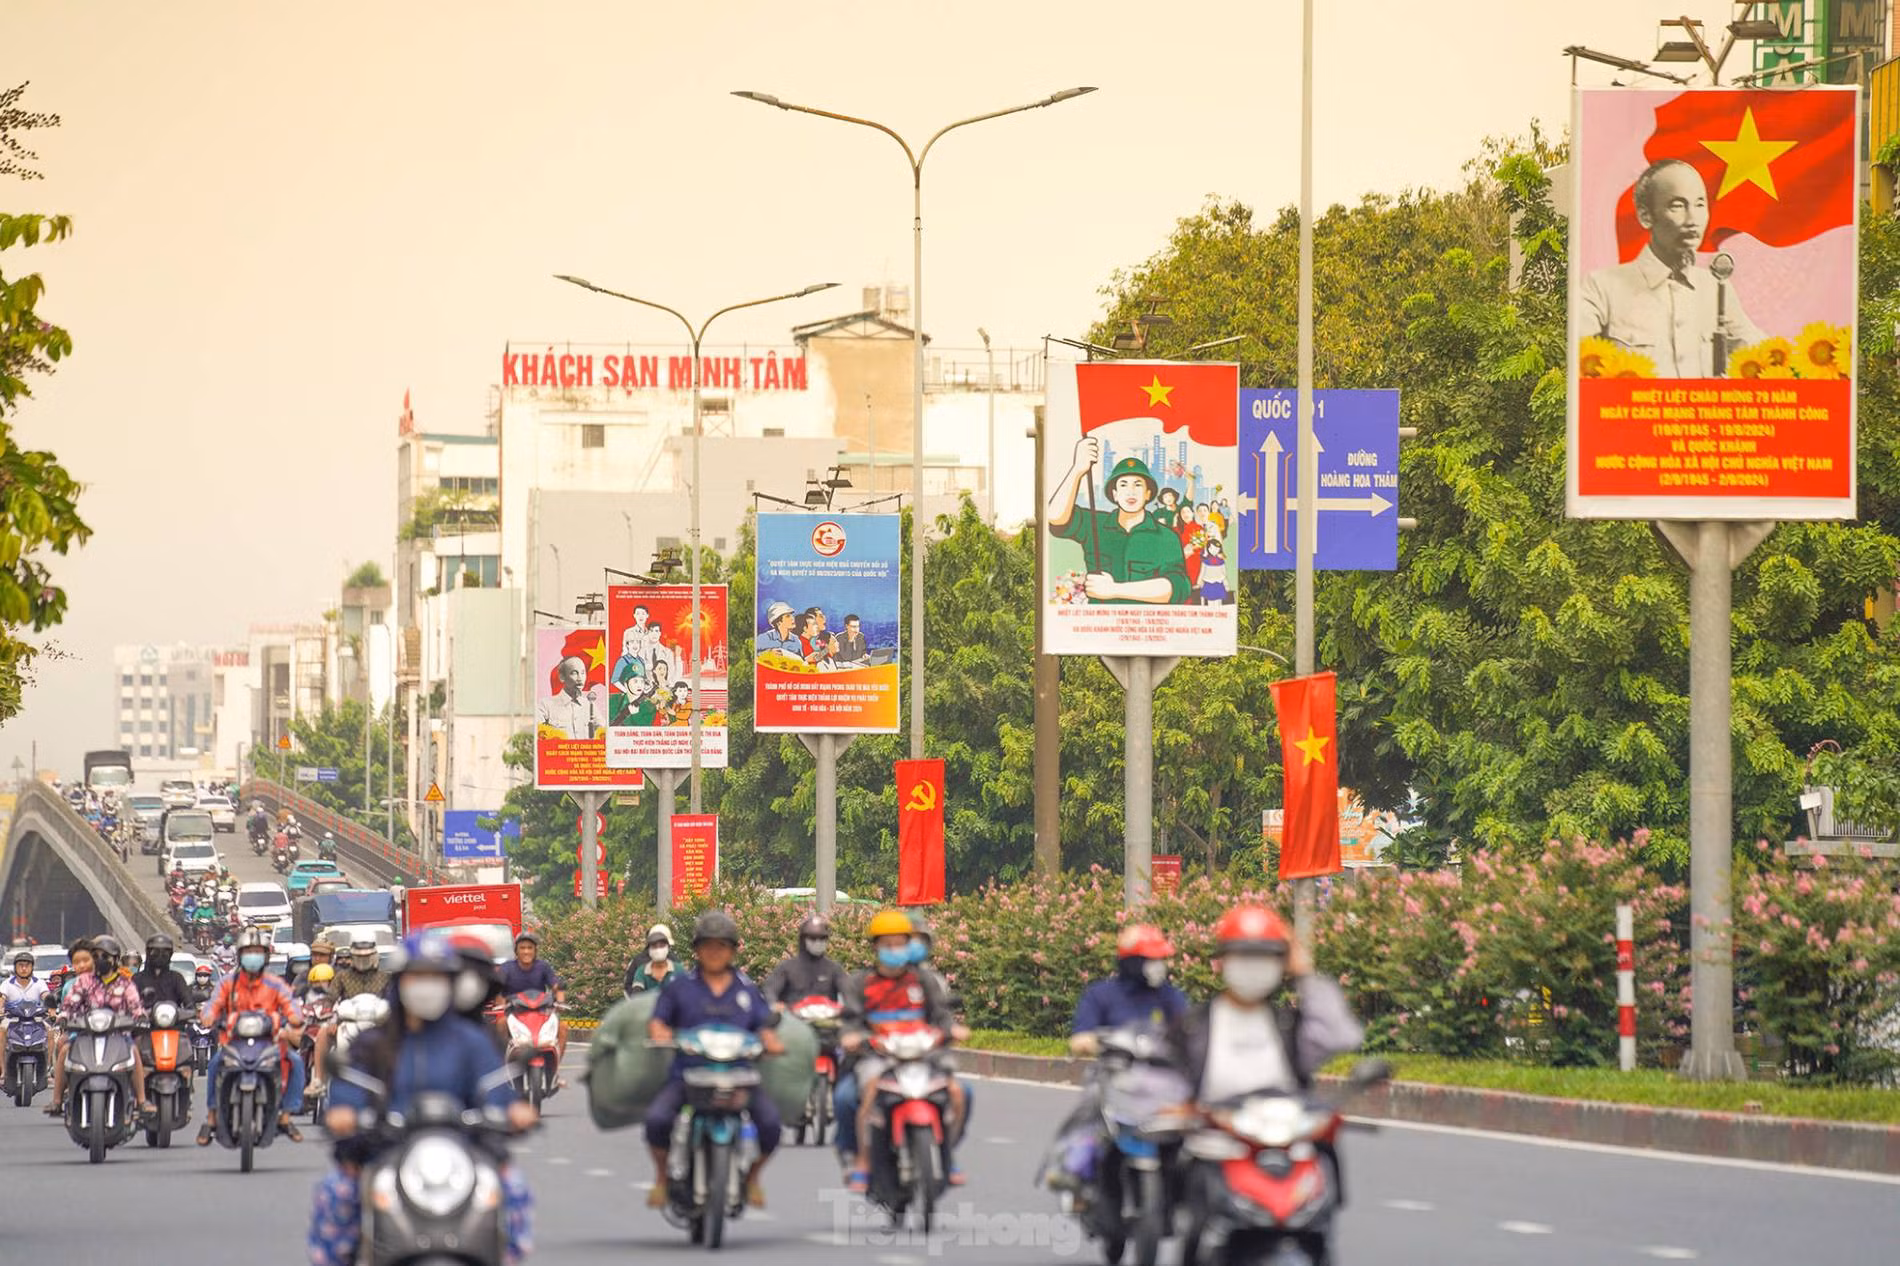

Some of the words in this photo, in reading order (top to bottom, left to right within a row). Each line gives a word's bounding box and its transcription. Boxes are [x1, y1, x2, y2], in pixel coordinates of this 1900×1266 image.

[503, 346, 593, 387] KHÁCH
[603, 355, 658, 395] SẠN
[750, 350, 808, 389] TÂM
[1252, 392, 1291, 419] QUỐC
[1318, 400, 1324, 418] 1
[443, 893, 486, 904] viettel
